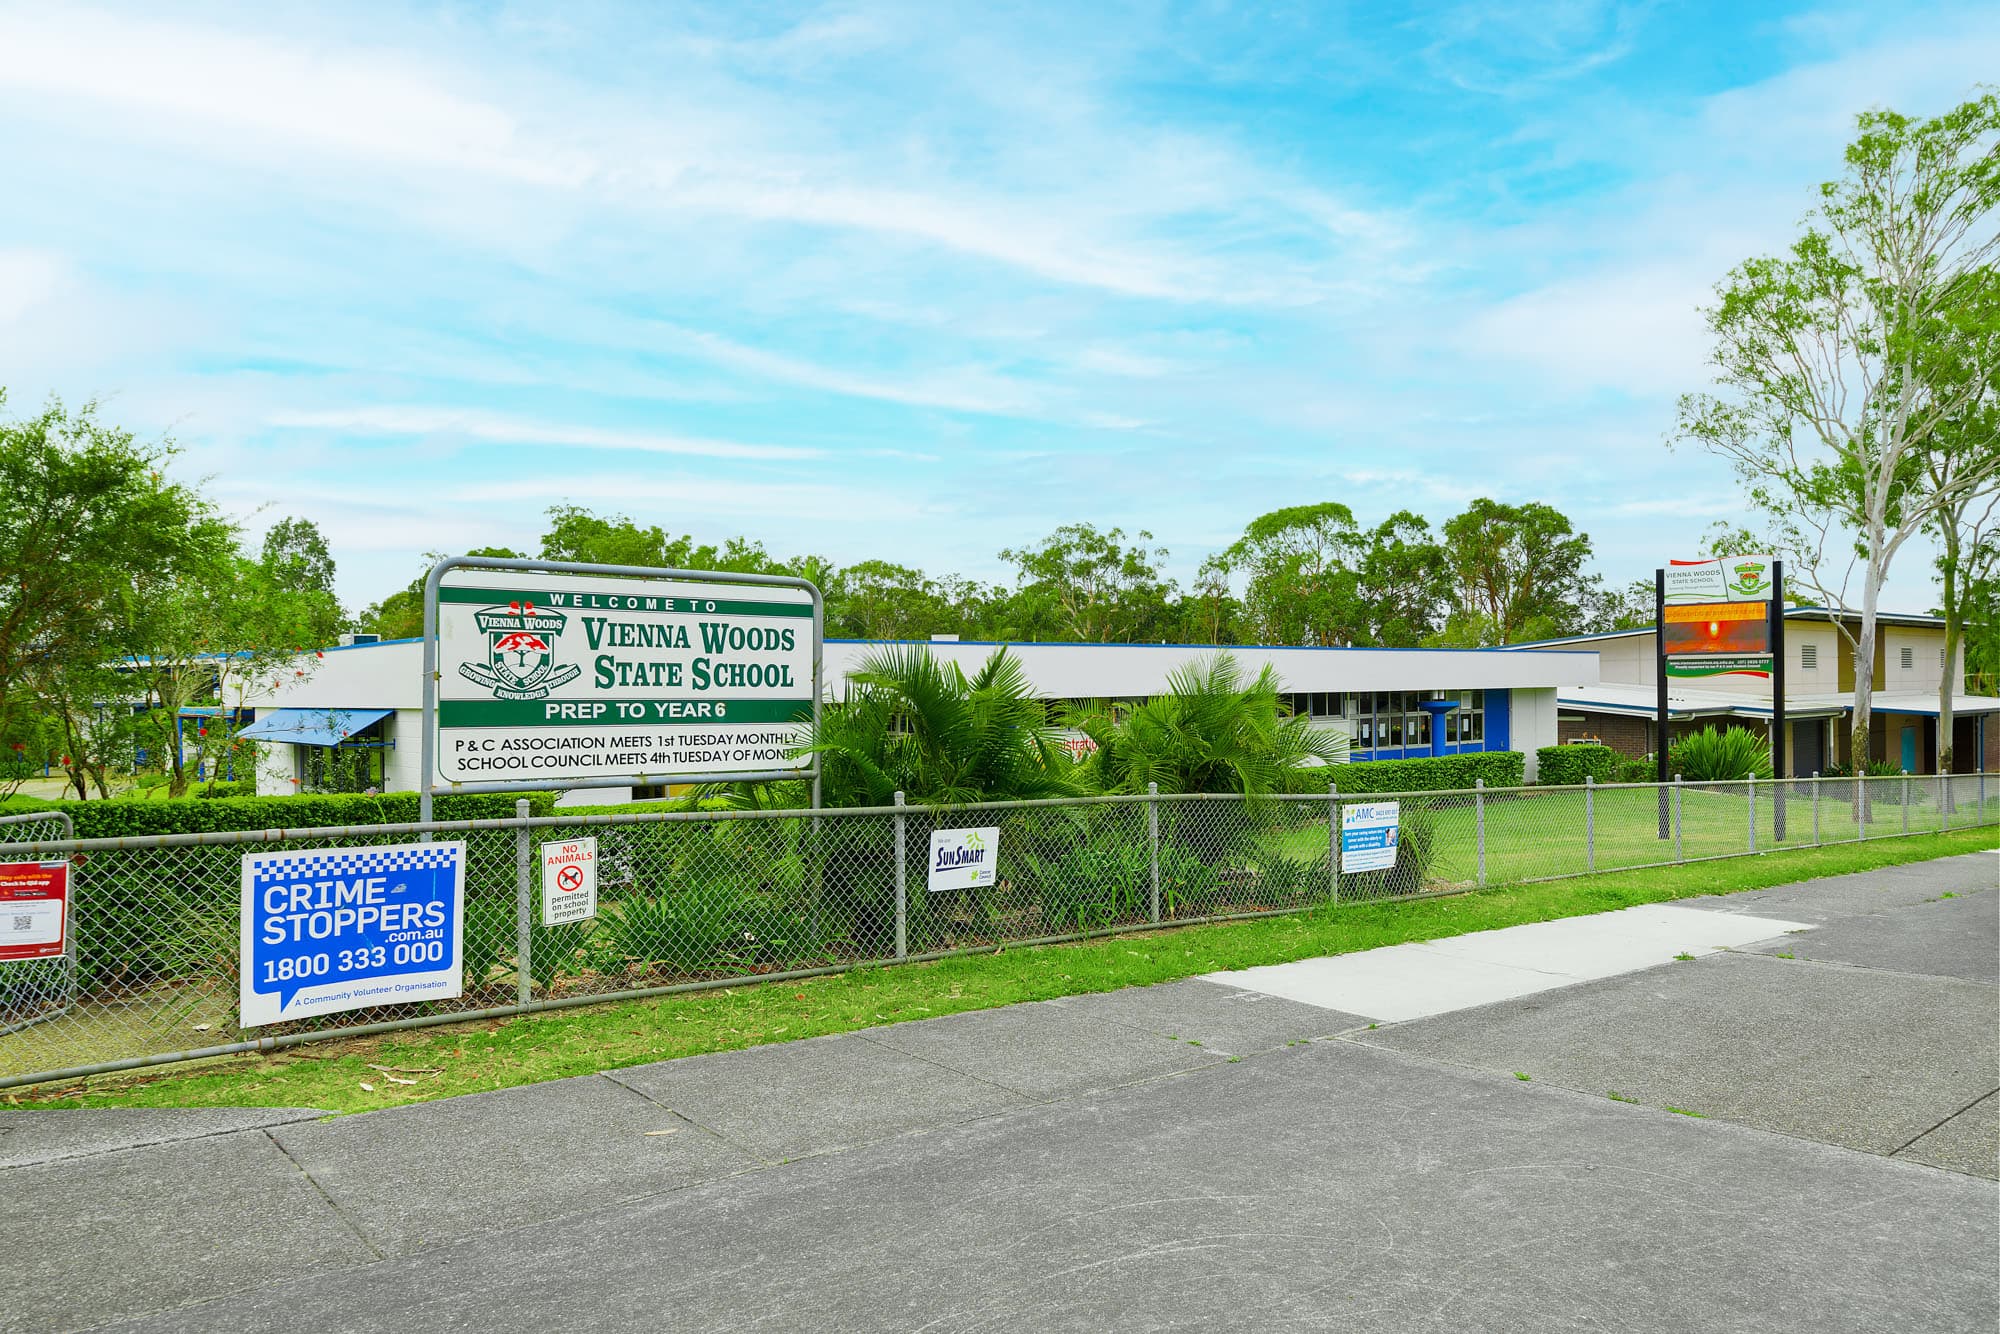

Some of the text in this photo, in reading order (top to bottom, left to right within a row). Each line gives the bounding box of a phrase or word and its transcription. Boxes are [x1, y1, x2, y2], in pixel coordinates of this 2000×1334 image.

[1665, 570, 1692, 578] VIENNA
[550, 593, 717, 613] WELCOME TO
[479, 615, 562, 629] VIENNA WOODS
[581, 616, 795, 654] VIENNA WOODS
[460, 665, 580, 700] GROWING KNOWLEDGE THROUGH
[495, 661, 548, 686] STATE SCHOOL
[594, 654, 794, 691] STATE SCHOOL
[545, 702, 727, 720] PREP TO YEAR 6
[456, 732, 798, 752] P & C ASSOCIATION MEETS 1st TUESDAY MONTHLY
[457, 755, 528, 771] SCHOOL
[531, 753, 604, 769] COUNCIL
[605, 752, 648, 765] MEETS
[650, 751, 671, 764] 4th
[673, 750, 729, 763] TUESDAY
[732, 749, 751, 761] OF
[1356, 808, 1375, 820] AMC
[547, 851, 593, 866] ANIMALS
[562, 844, 578, 854] NO
[263, 877, 387, 915] CRIME
[551, 890, 589, 905] permitted
[563, 898, 589, 909] school
[262, 901, 446, 945] STOPPERS
[554, 907, 587, 920] property
[384, 927, 444, 945] .com.au
[263, 941, 443, 983] 1800 333 000
[295, 979, 447, 1008] A Community Volunteer Organisation
